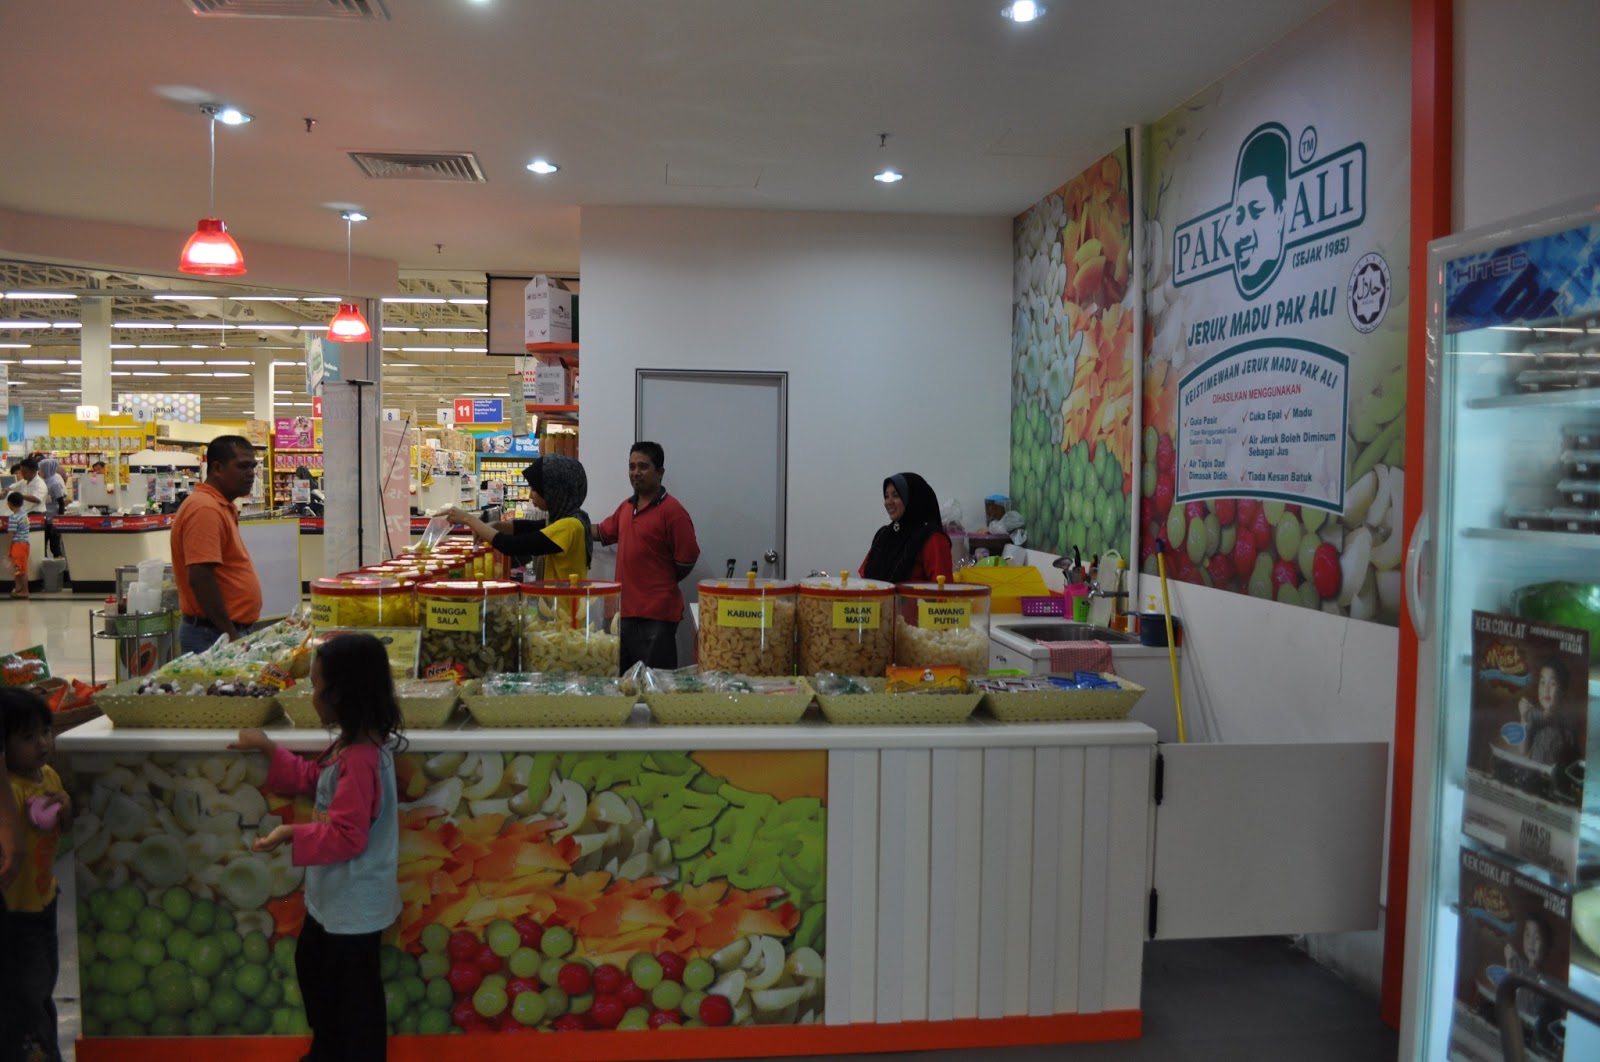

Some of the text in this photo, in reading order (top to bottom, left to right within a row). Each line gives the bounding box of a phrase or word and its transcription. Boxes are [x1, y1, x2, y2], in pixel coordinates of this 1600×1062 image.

[1302, 138, 1314, 153] TM
[1176, 159, 1354, 276] PAK ALI
[1293, 236, 1349, 269] (SEJAK 1985)
[1187, 286, 1337, 347] JERUK MADU PAK ALI
[1185, 356, 1338, 406] KEISTIMEWAAN JERUK MADU PAK ALI
[1212, 384, 1301, 404] DIHASILKAN MENGGUNAKAN
[138, 410, 144, 419] 9
[387, 412, 393, 421] 8
[442, 412, 448, 420] 7
[458, 405, 470, 417] 11
[1249, 410, 1282, 421] Cuka Epal
[1292, 407, 1312, 418] Madu
[1249, 432, 1336, 444] Air Jeruk Boleh Diminum
[1248, 446, 1289, 458] Sebagai Jus
[1189, 459, 1225, 469] Air Tapis Dan
[1248, 471, 1312, 482] Tiada Kesan Batuk
[431, 606, 467, 616] MANGGA
[727, 609, 764, 619] KABUNG
[844, 607, 872, 615] SALAK
[928, 608, 965, 616] BAWANG
[437, 617, 459, 625] SALA
[846, 616, 870, 624] MADU
[934, 616, 959, 625] PUTIH
[1475, 617, 1527, 639] KEK COKLAT
[428, 663, 450, 677] New!
[1480, 860, 1511, 887] COKLAT
